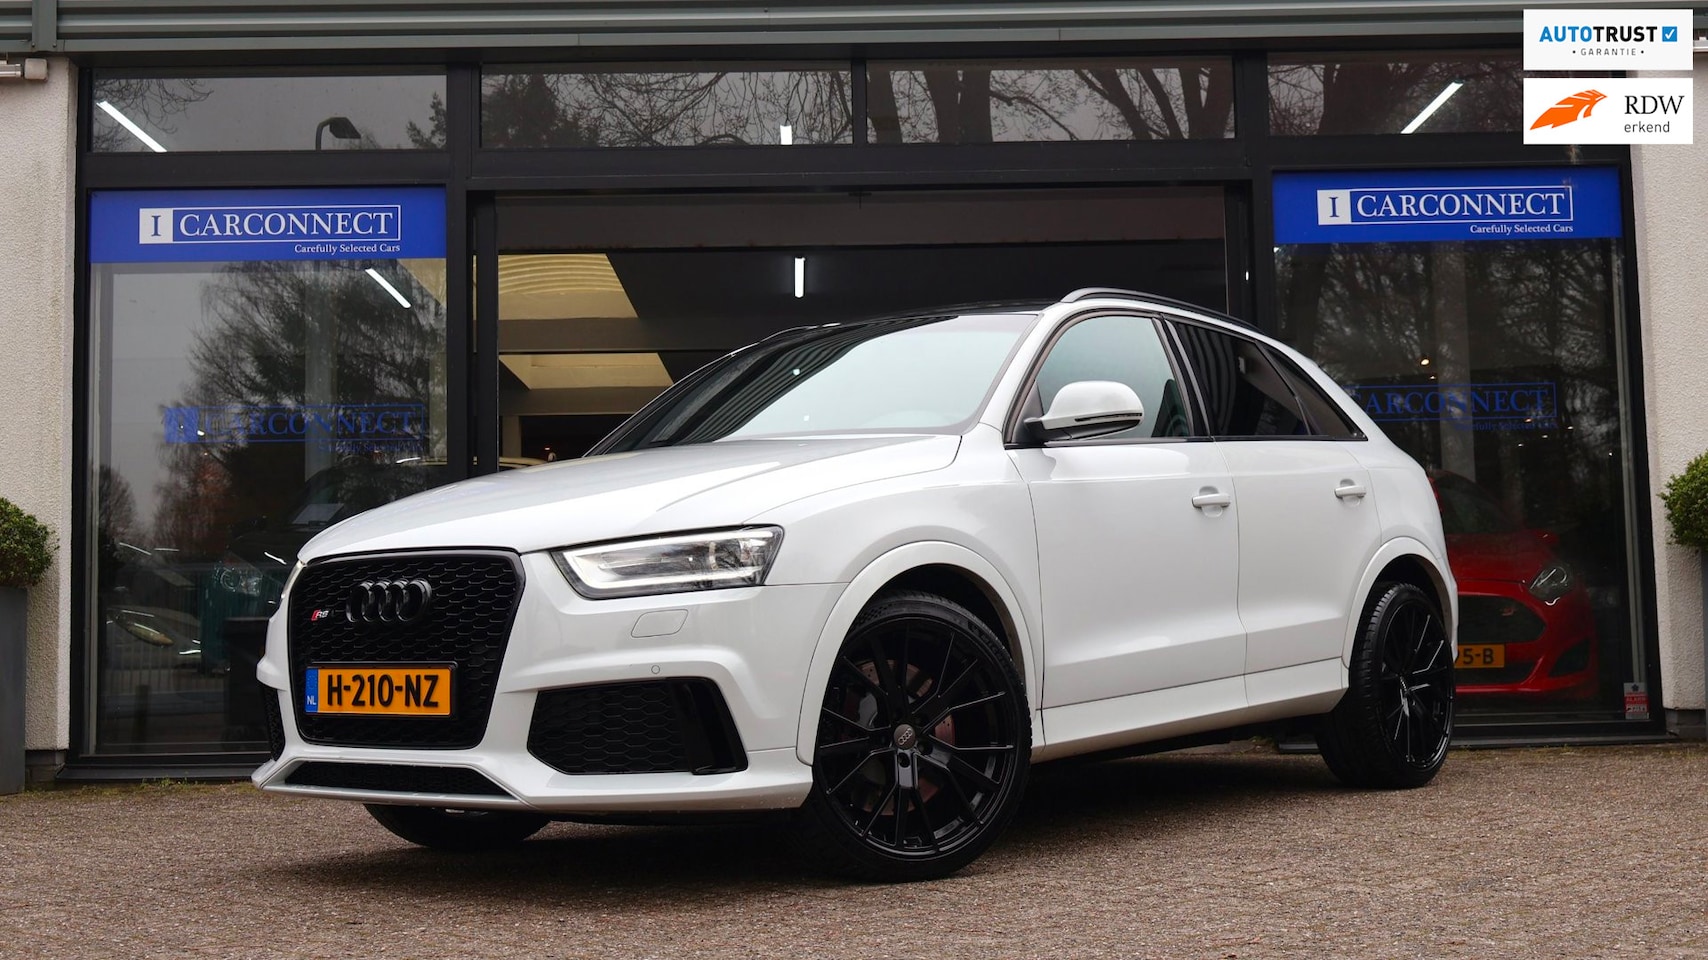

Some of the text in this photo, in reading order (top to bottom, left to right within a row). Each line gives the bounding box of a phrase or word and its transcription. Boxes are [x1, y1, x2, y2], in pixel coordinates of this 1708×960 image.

[1329, 192, 1565, 218] I CARCONNECT
[150, 211, 393, 237] I CARCONNECT
[1470, 224, 1573, 235] Carefully Selected Cars
[294, 243, 400, 255] Carefully Selected Cars
[306, 695, 317, 706] NL
[327, 674, 439, 708] H-210-NZ
